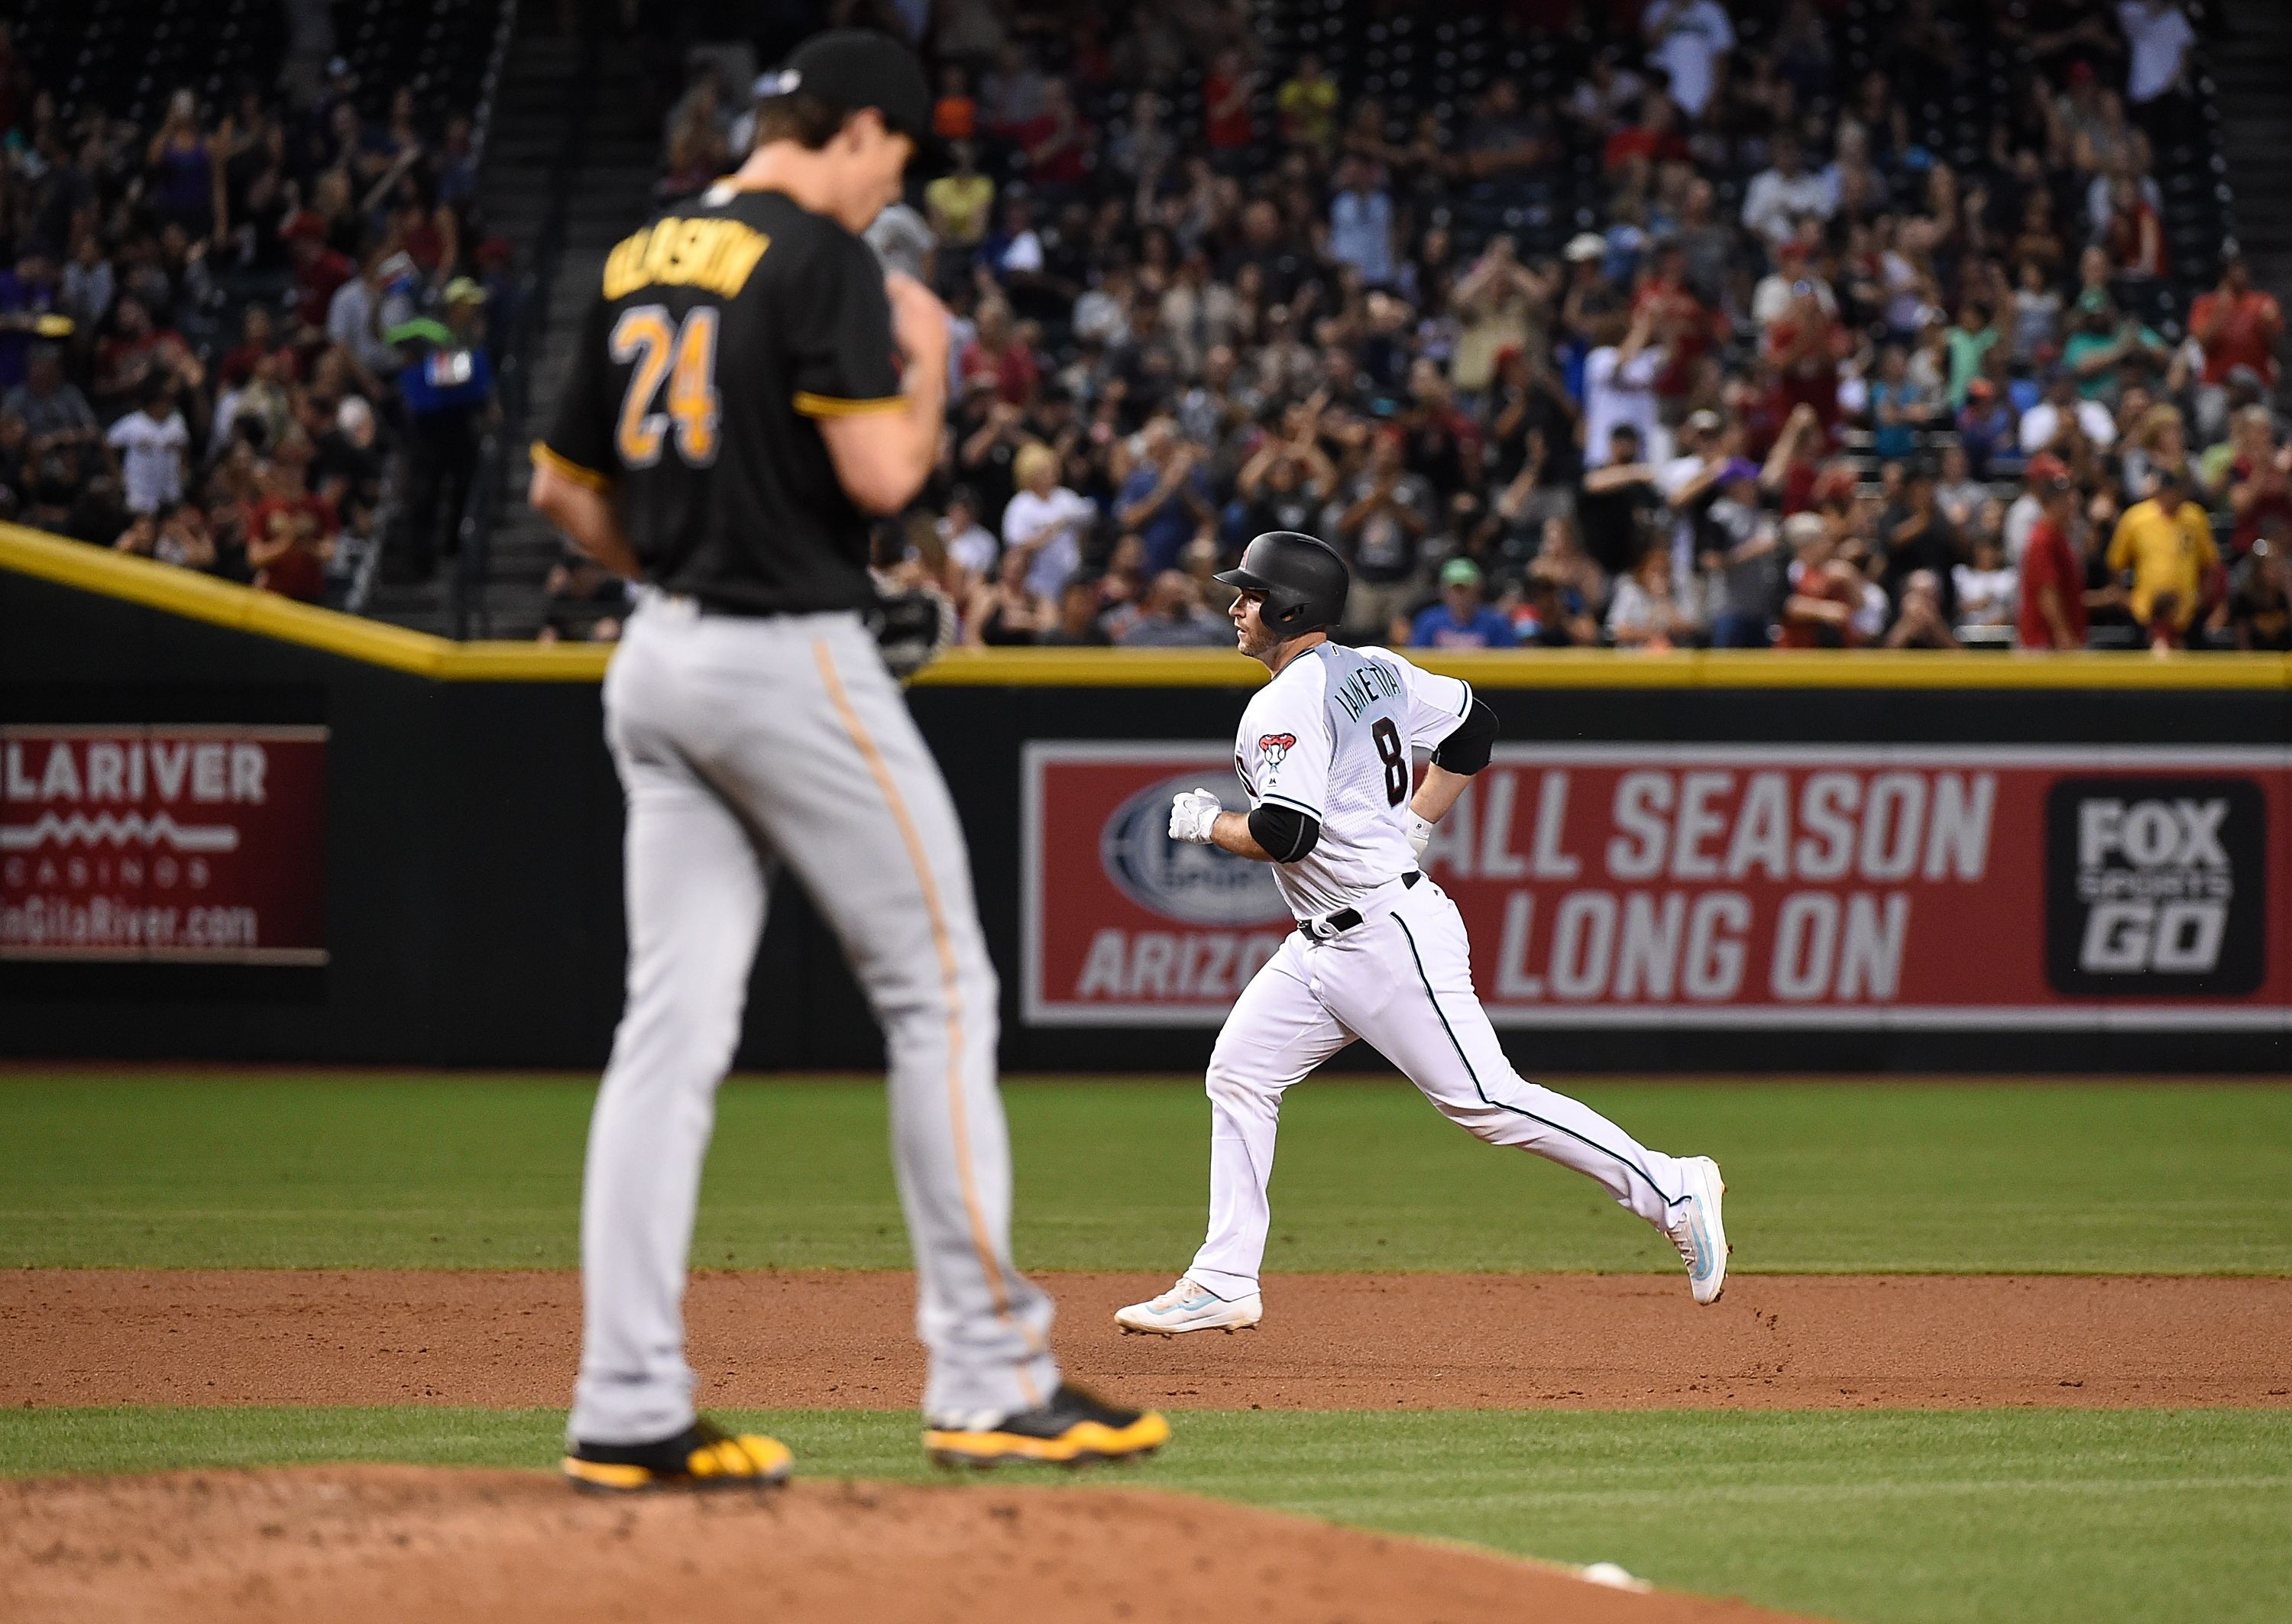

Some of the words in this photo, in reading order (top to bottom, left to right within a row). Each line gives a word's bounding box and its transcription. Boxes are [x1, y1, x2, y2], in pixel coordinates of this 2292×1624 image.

[609, 305, 723, 469] 24
[1371, 716, 1407, 808] 8
[1420, 770, 1583, 880] ALL
[1606, 770, 1996, 882] SEASON
[2076, 797, 2231, 869] FOX
[1494, 888, 1754, 1001] LONG
[1768, 889, 1910, 1001] ON
[2078, 903, 2229, 974] GO
